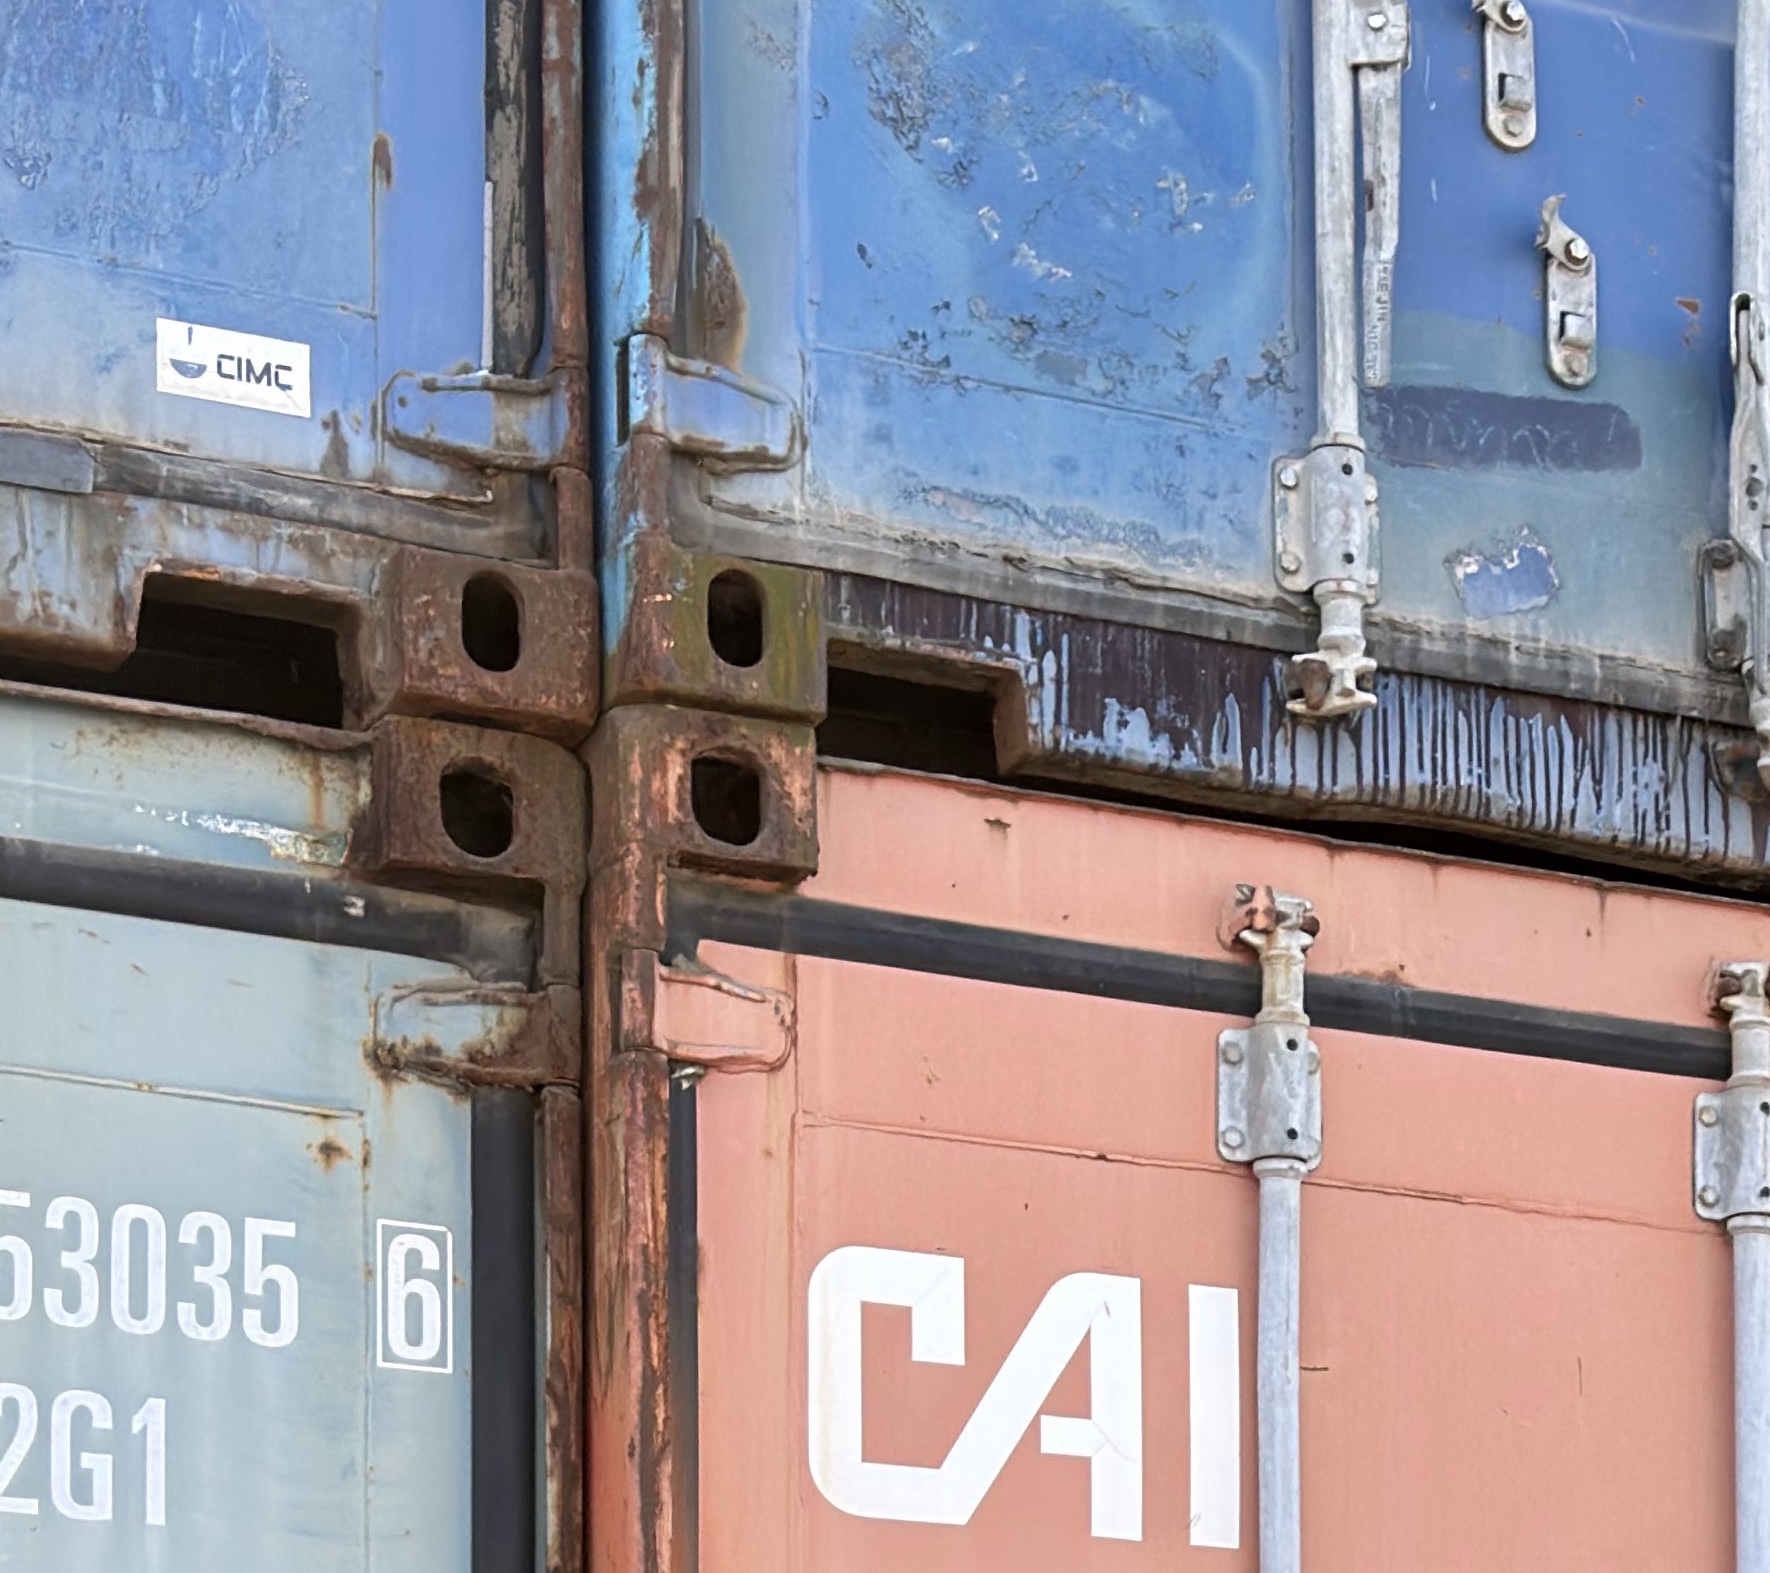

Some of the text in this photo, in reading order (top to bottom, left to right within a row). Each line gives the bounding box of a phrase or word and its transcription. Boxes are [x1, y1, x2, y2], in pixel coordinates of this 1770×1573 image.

[217, 354, 292, 391] CIMC
[386, 1233, 444, 1362] 6
[0, 1383, 165, 1526] 2G1
[808, 1246, 1240, 1548] CAI
